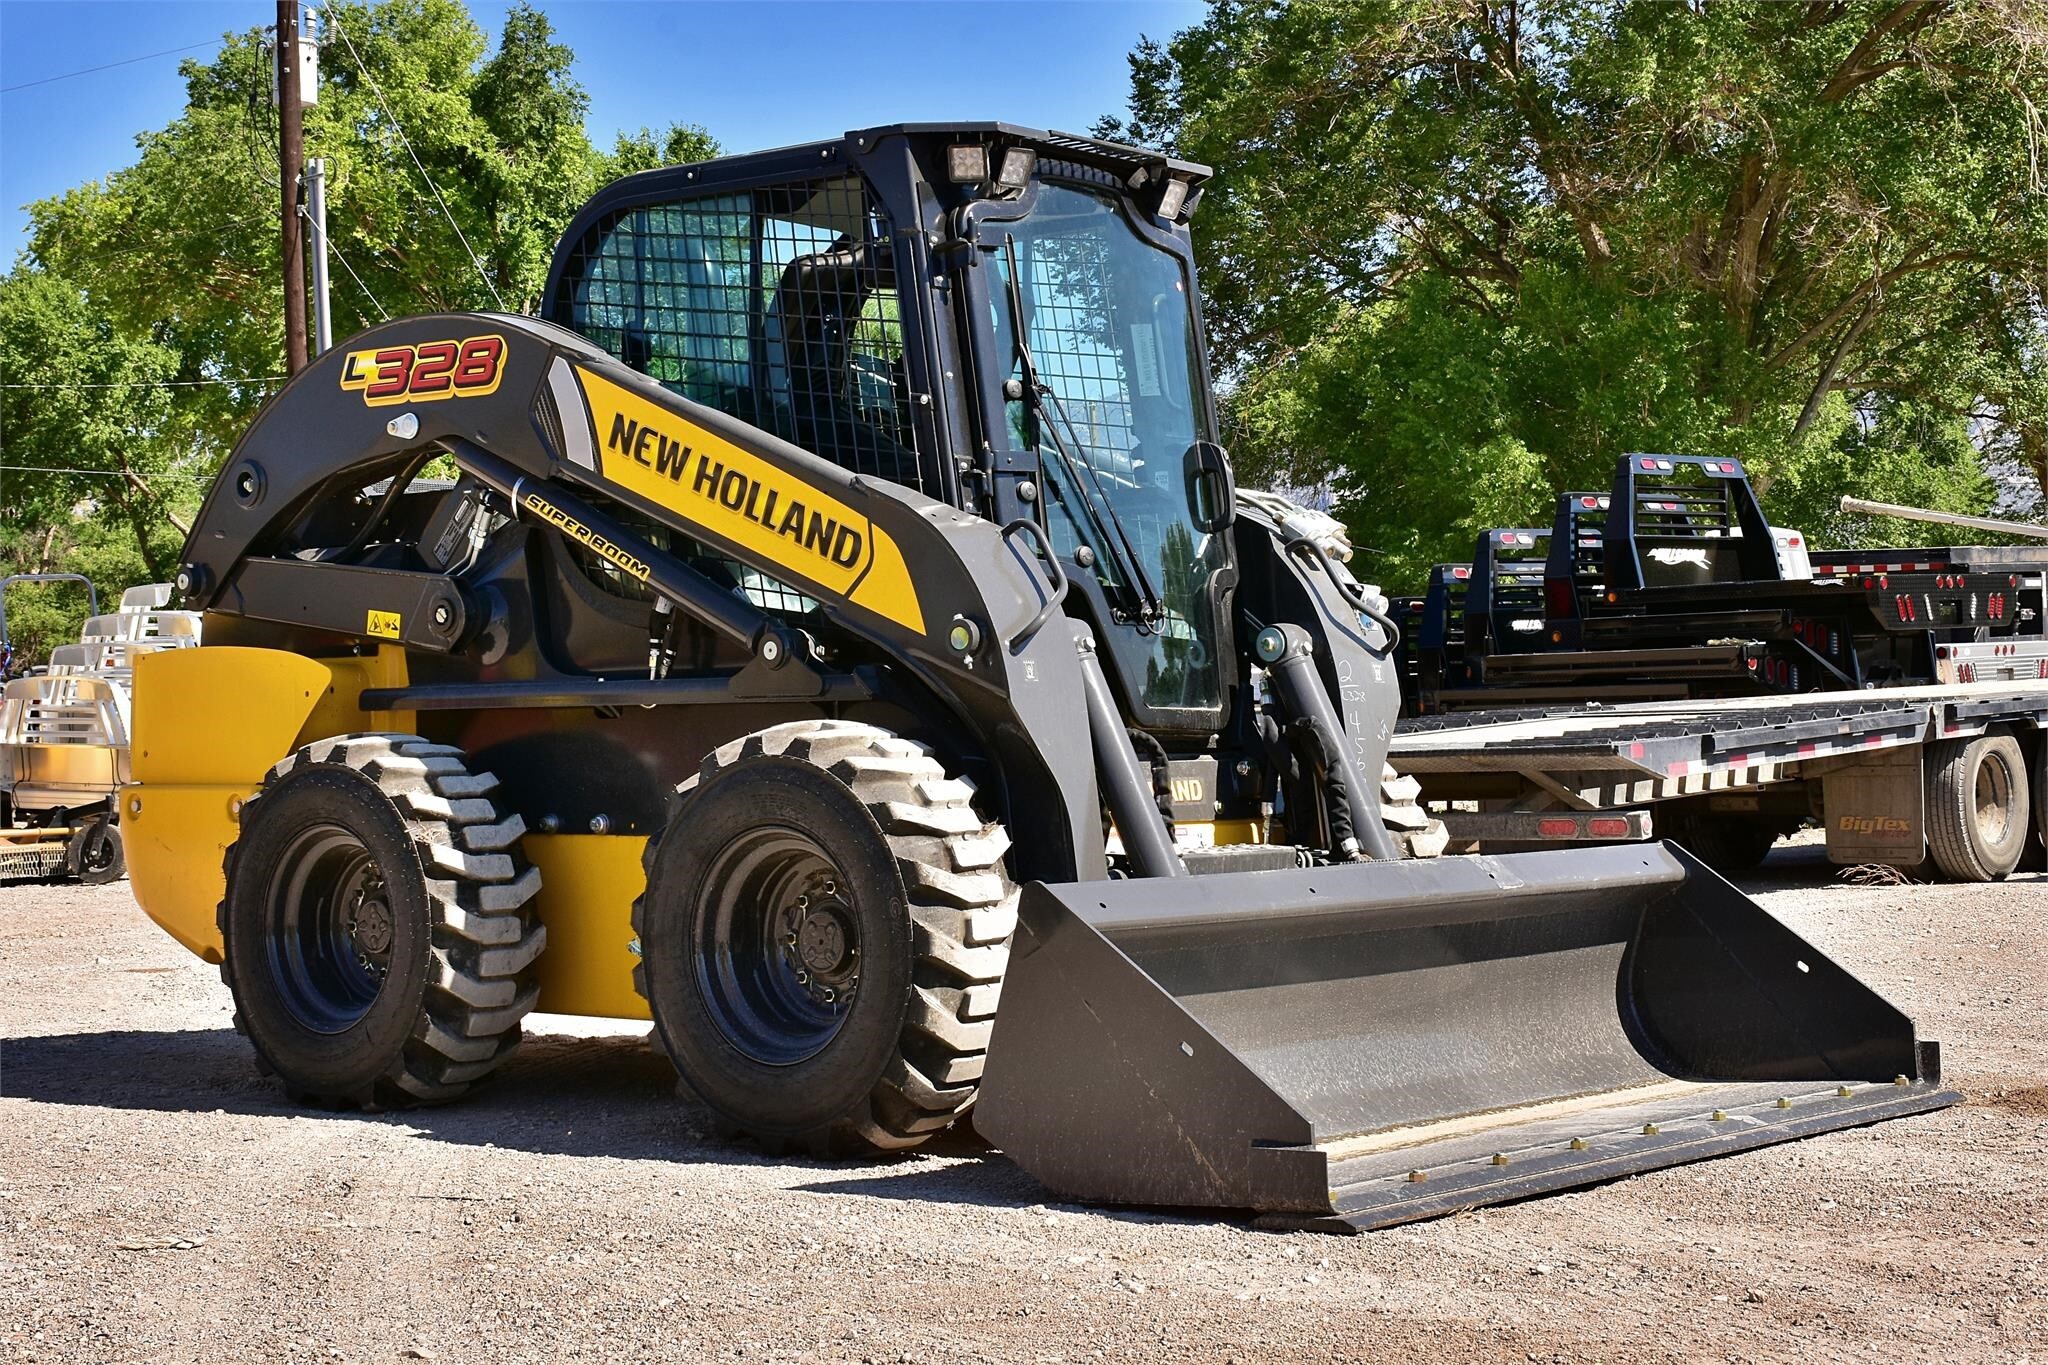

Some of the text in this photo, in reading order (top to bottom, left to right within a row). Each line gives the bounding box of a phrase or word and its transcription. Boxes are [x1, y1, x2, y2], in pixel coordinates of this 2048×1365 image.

[607, 411, 863, 570] NEW HOLLAND
[527, 495, 592, 541] SUPER
[592, 540, 649, 584] BOOM
[1838, 815, 1911, 834] BigTex
